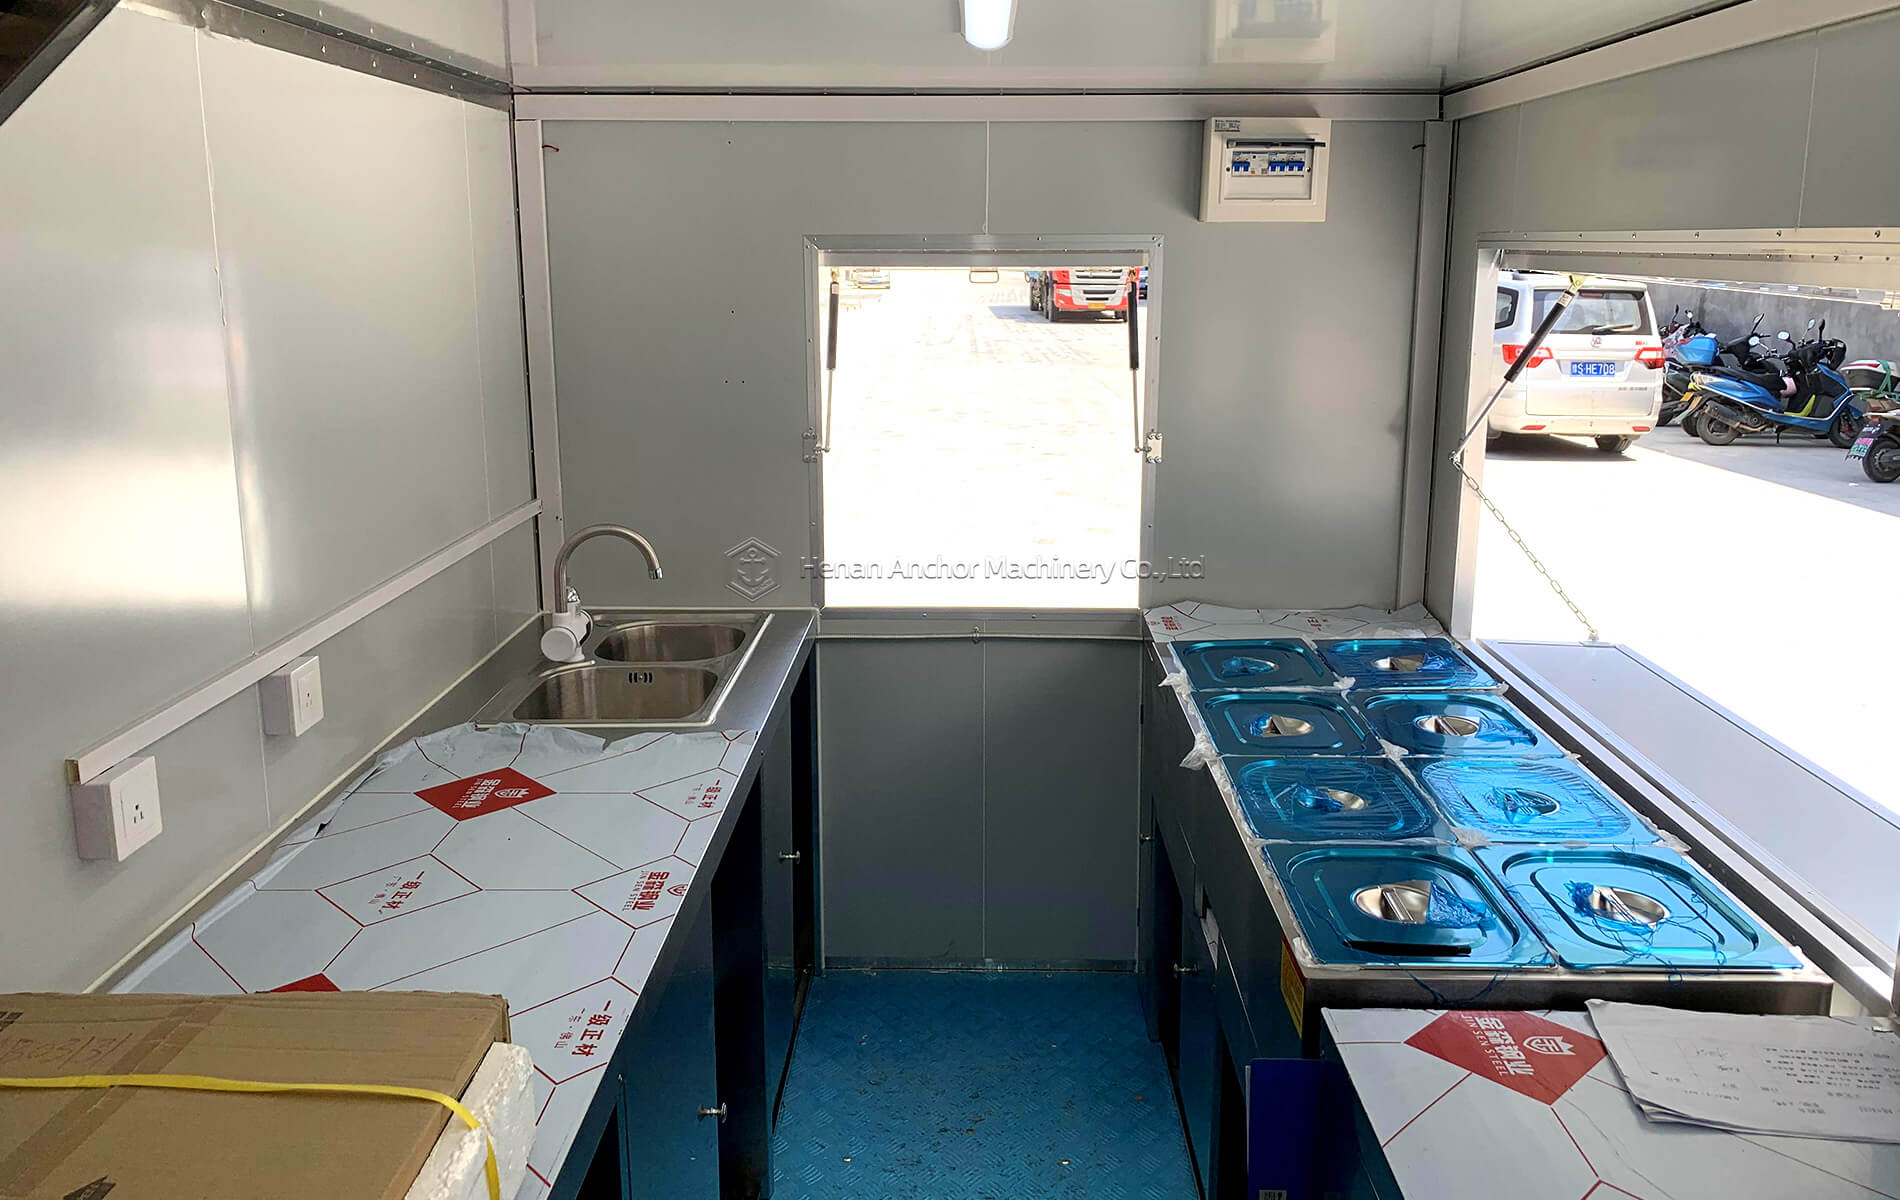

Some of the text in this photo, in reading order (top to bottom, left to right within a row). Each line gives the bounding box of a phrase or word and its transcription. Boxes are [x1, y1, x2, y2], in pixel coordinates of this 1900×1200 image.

[1571, 363, 1615, 376] S·HE708
[571, 1000, 612, 1057] 一级正材
[1461, 1012, 1507, 1077] JIN SEN STEEL
[1474, 1015, 1535, 1076] 金森钢业
